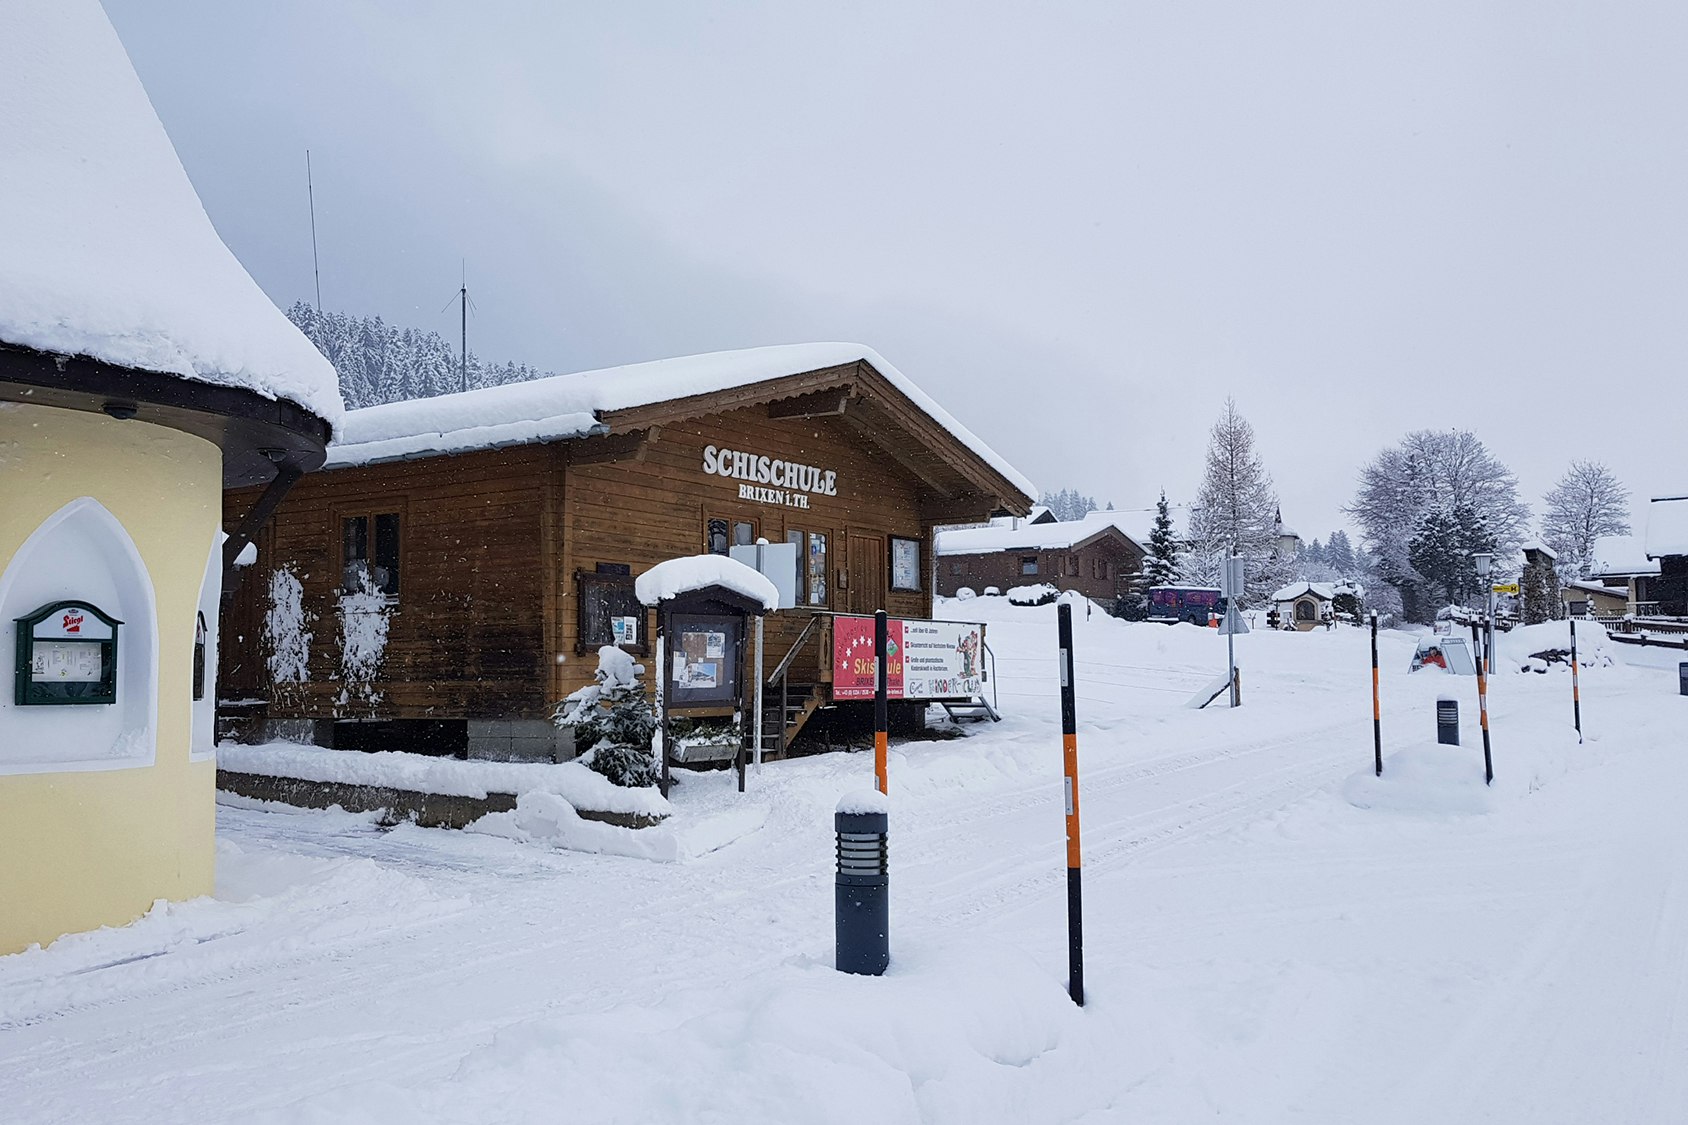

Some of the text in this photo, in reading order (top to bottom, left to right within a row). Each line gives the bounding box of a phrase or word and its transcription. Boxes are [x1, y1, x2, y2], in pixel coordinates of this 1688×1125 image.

[703, 445, 837, 496] SCHISCHULE
[738, 484, 784, 504] BRIXEN
[854, 658, 901, 675] Skisule
